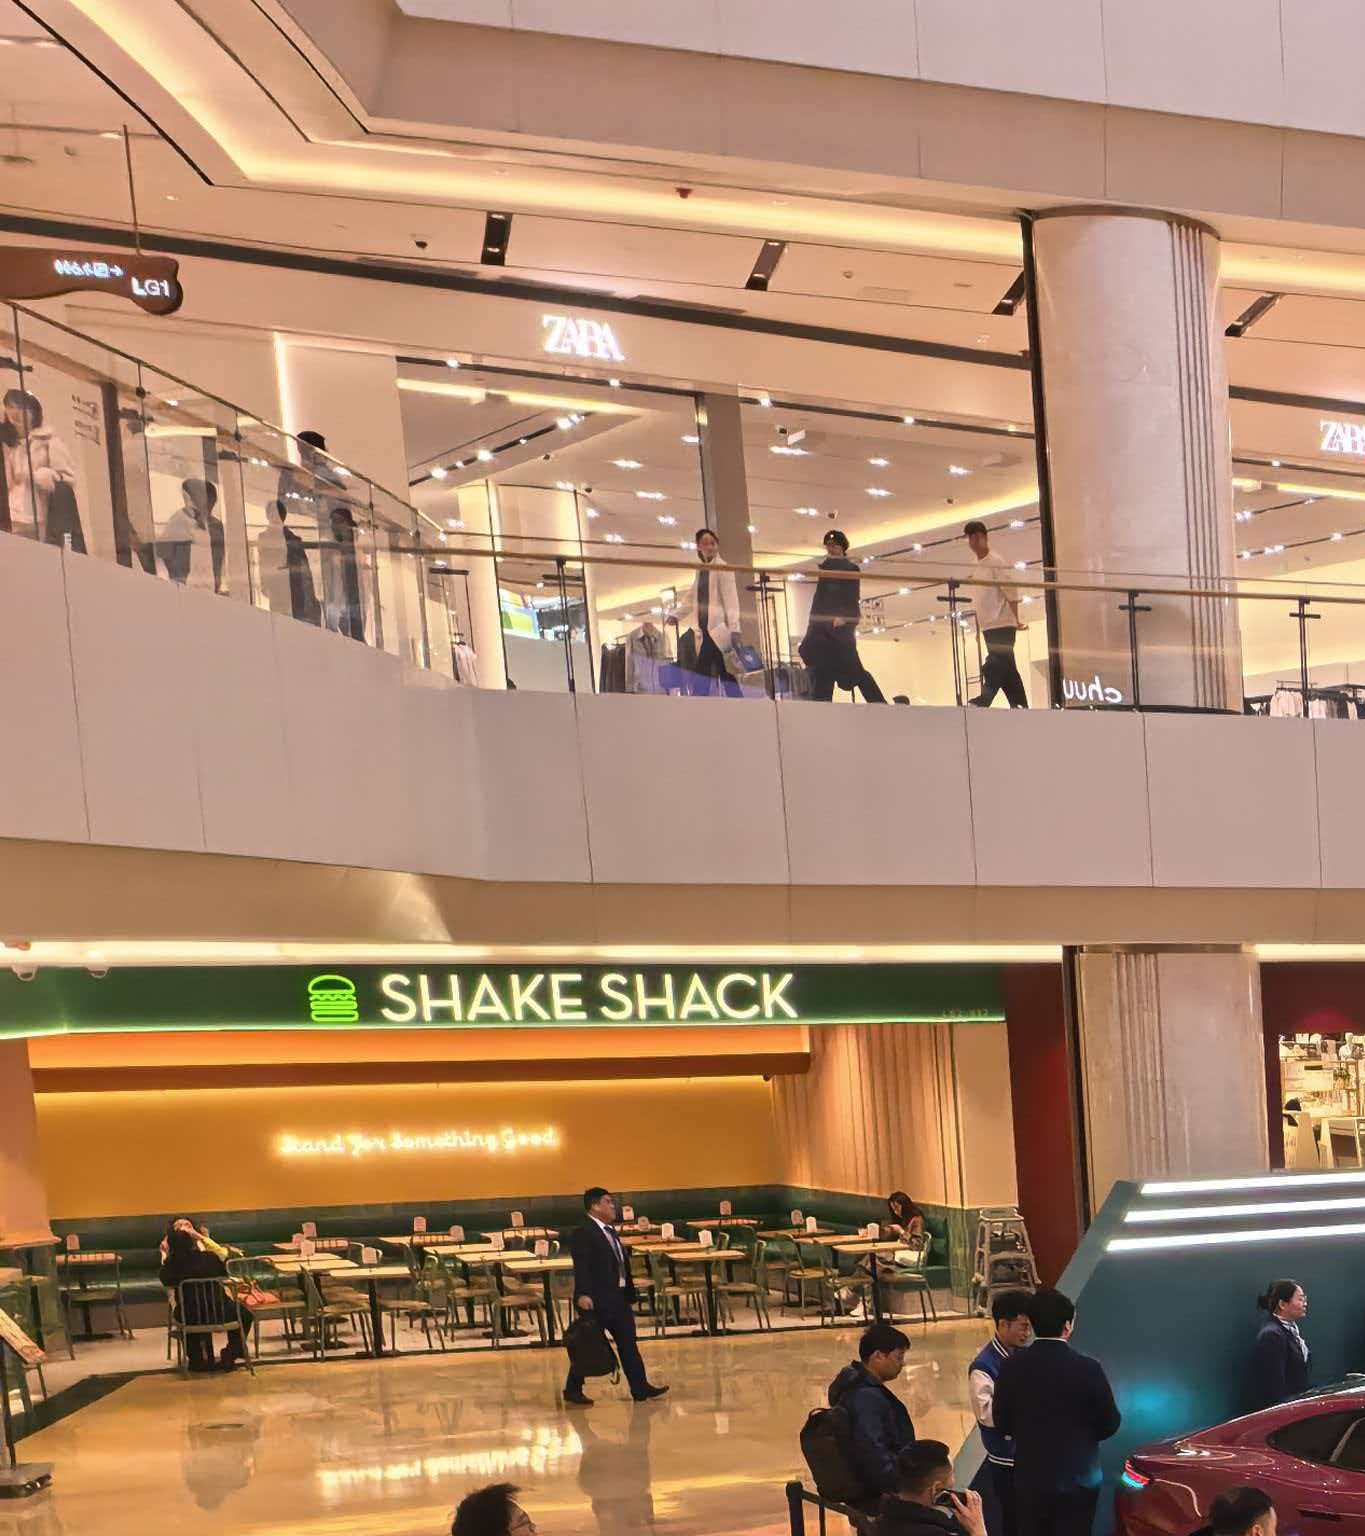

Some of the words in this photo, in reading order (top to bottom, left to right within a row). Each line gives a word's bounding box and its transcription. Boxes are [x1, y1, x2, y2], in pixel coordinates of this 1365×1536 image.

[131, 277, 170, 297] LG1
[543, 314, 626, 361] ZARA
[381, 972, 588, 1022] SHAKE
[600, 972, 798, 1020] SHACK
